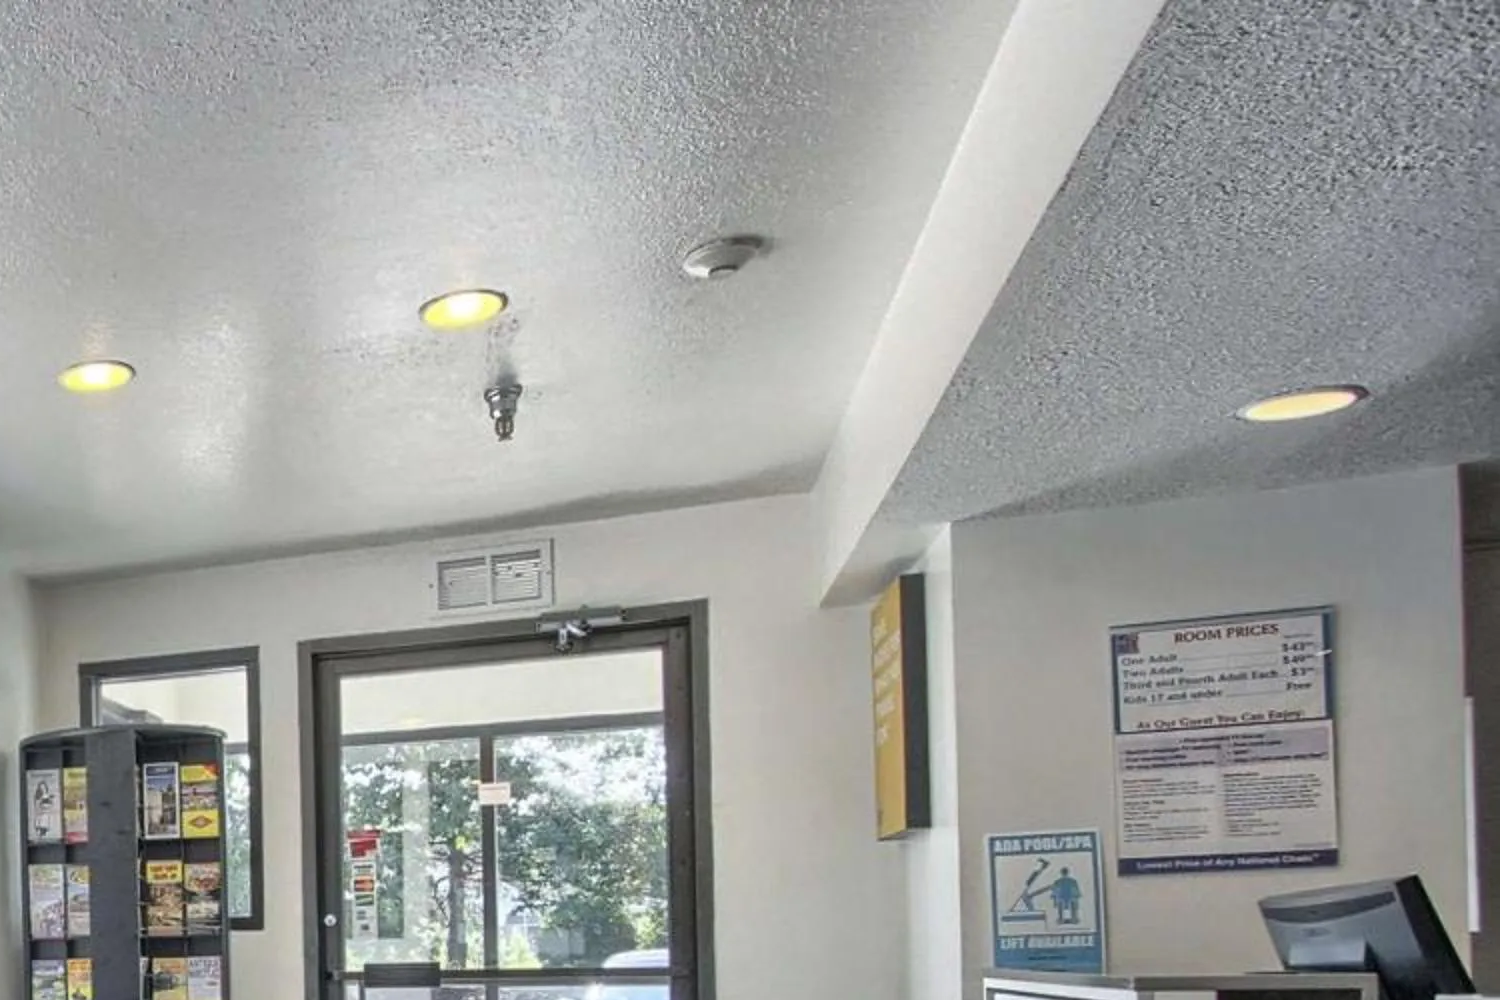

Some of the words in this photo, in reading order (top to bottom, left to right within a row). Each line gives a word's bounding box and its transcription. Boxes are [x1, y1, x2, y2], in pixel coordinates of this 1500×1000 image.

[1173, 628, 1221, 643] ROOM
[1226, 624, 1280, 638] PRICES
[1121, 657, 1144, 666] One
[1148, 654, 1177, 662] Adult
[1122, 668, 1147, 678] Two
[1149, 666, 1184, 675] Adults
[1123, 681, 1152, 690] Third
[1156, 678, 1175, 686] and
[1177, 675, 1214, 685] Fourth
[1217, 672, 1247, 681] Adult
[1251, 669, 1279, 679] Each
[1123, 694, 1148, 704] Kids
[1166, 692, 1187, 700] and
[1190, 688, 1223, 699] under
[1286, 681, 1313, 691] Free
[1138, 721, 1151, 729] As
[1154, 719, 1177, 728] Our
[1179, 716, 1214, 726] Guest
[1216, 714, 1237, 723] You
[1241, 711, 1265, 720] Can
[1136, 860, 1172, 871] Lowest
[1175, 859, 1201, 868] Price
[1203, 858, 1214, 867] of
[1215, 857, 1236, 867] Any
[1237, 855, 1280, 865] National
